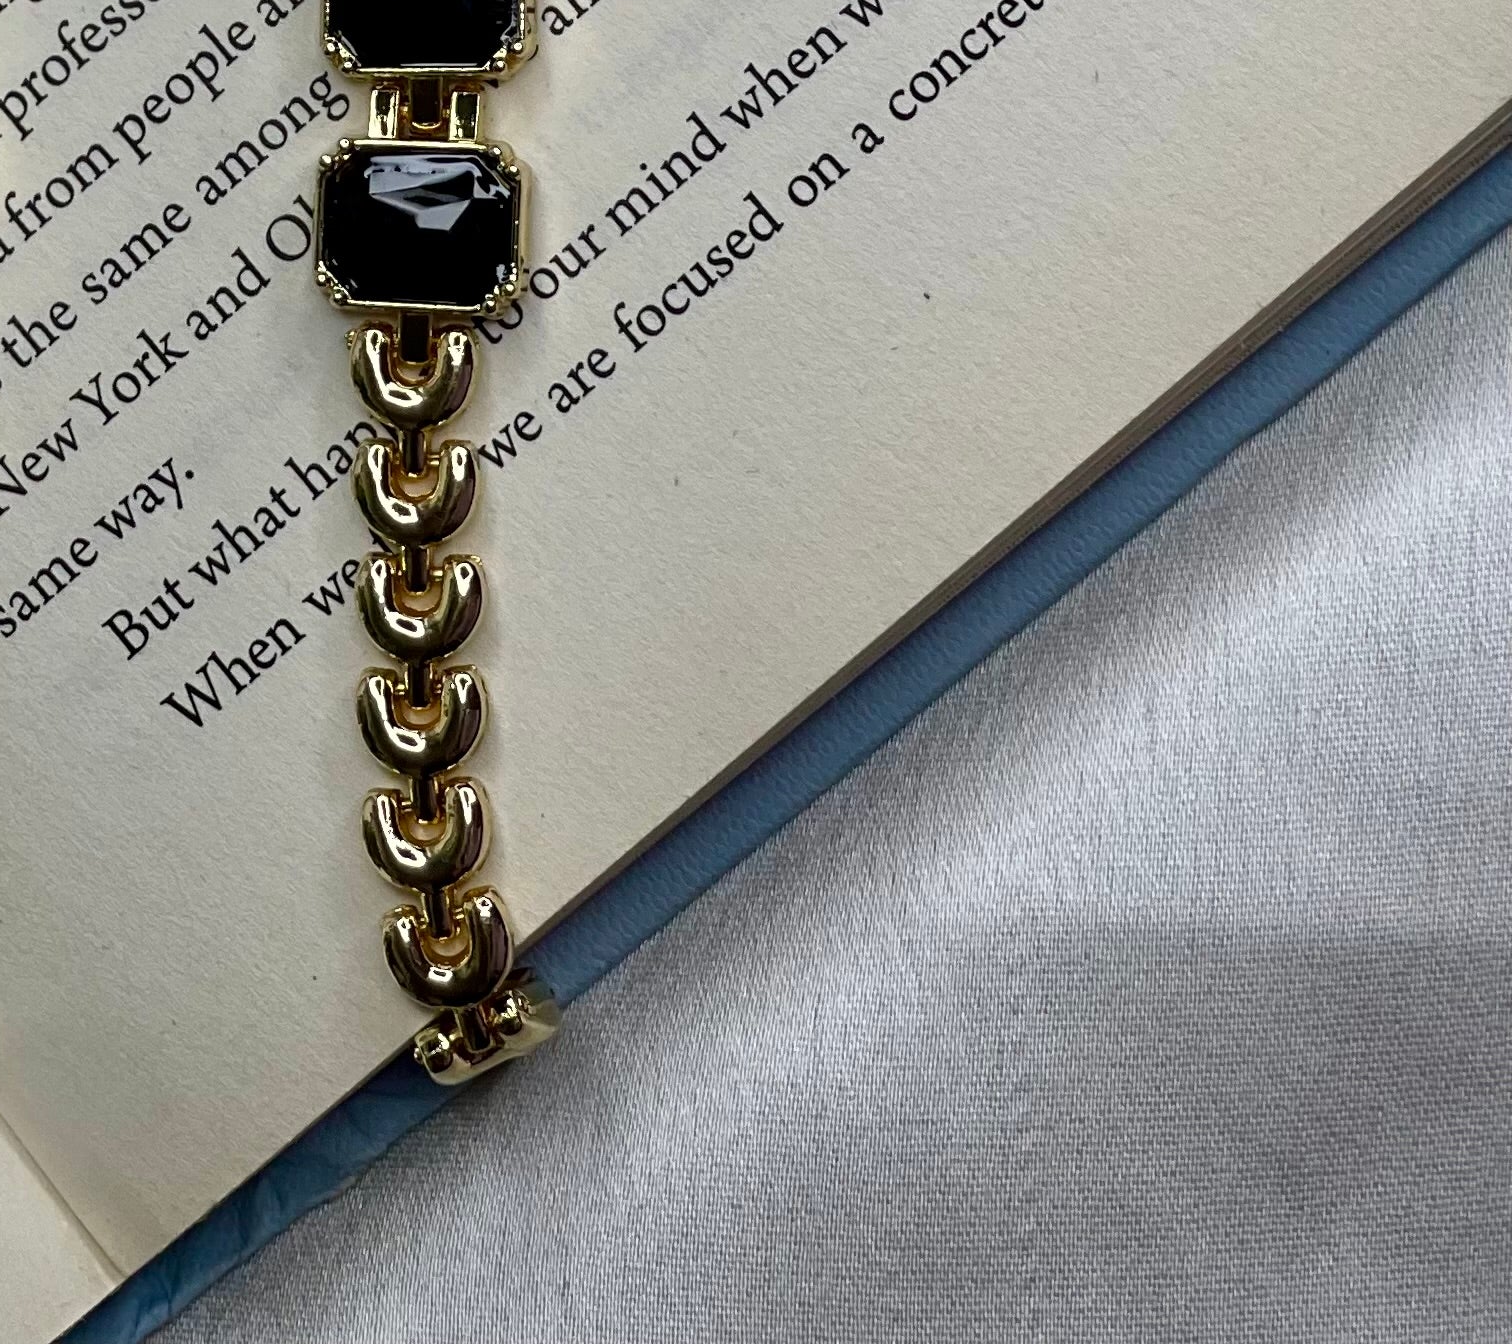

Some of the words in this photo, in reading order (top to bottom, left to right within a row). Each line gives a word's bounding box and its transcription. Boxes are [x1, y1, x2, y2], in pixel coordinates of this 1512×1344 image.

[1, 301, 78, 368] the
[82, 203, 192, 304] same
[196, 60, 363, 205] among
[5, 143, 120, 241] from
[112, 21, 257, 164] people
[69, 331, 189, 425] York
[186, 247, 271, 340] and
[102, 578, 195, 660] But
[188, 486, 301, 585] what
[523, 223, 606, 299] our
[605, 113, 727, 236] mind
[720, 26, 848, 128] when
[160, 618, 306, 727] When
[473, 411, 543, 468] we
[548, 348, 617, 414] are
[614, 193, 784, 352] focused
[788, 153, 850, 207] on
[851, 123, 885, 154] a
[94, 457, 195, 539] way.
